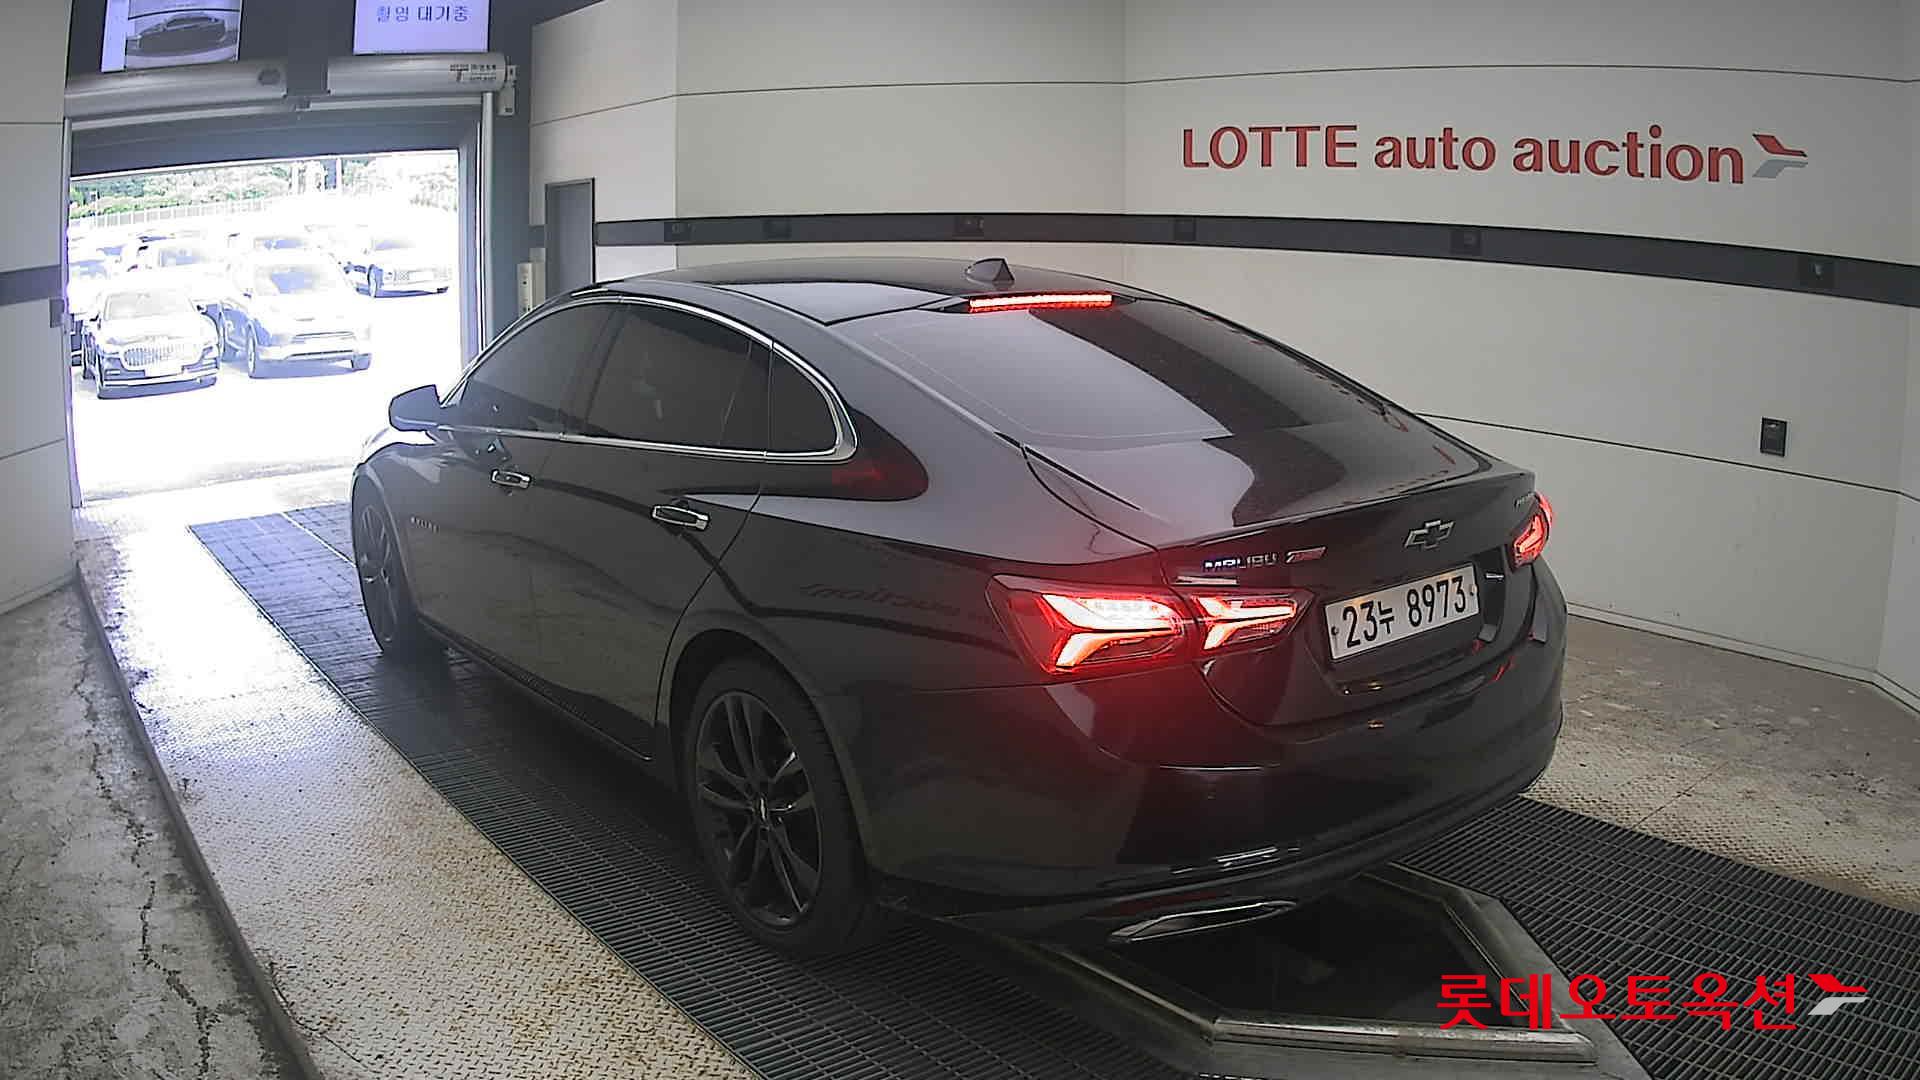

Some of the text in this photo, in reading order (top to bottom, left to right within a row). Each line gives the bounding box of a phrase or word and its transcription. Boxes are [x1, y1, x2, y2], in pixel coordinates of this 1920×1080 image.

[417, 5, 469, 22] 대기중
[1183, 125, 1744, 184] LOTTE auto auction
[1342, 575, 1467, 649] 23누 8973
